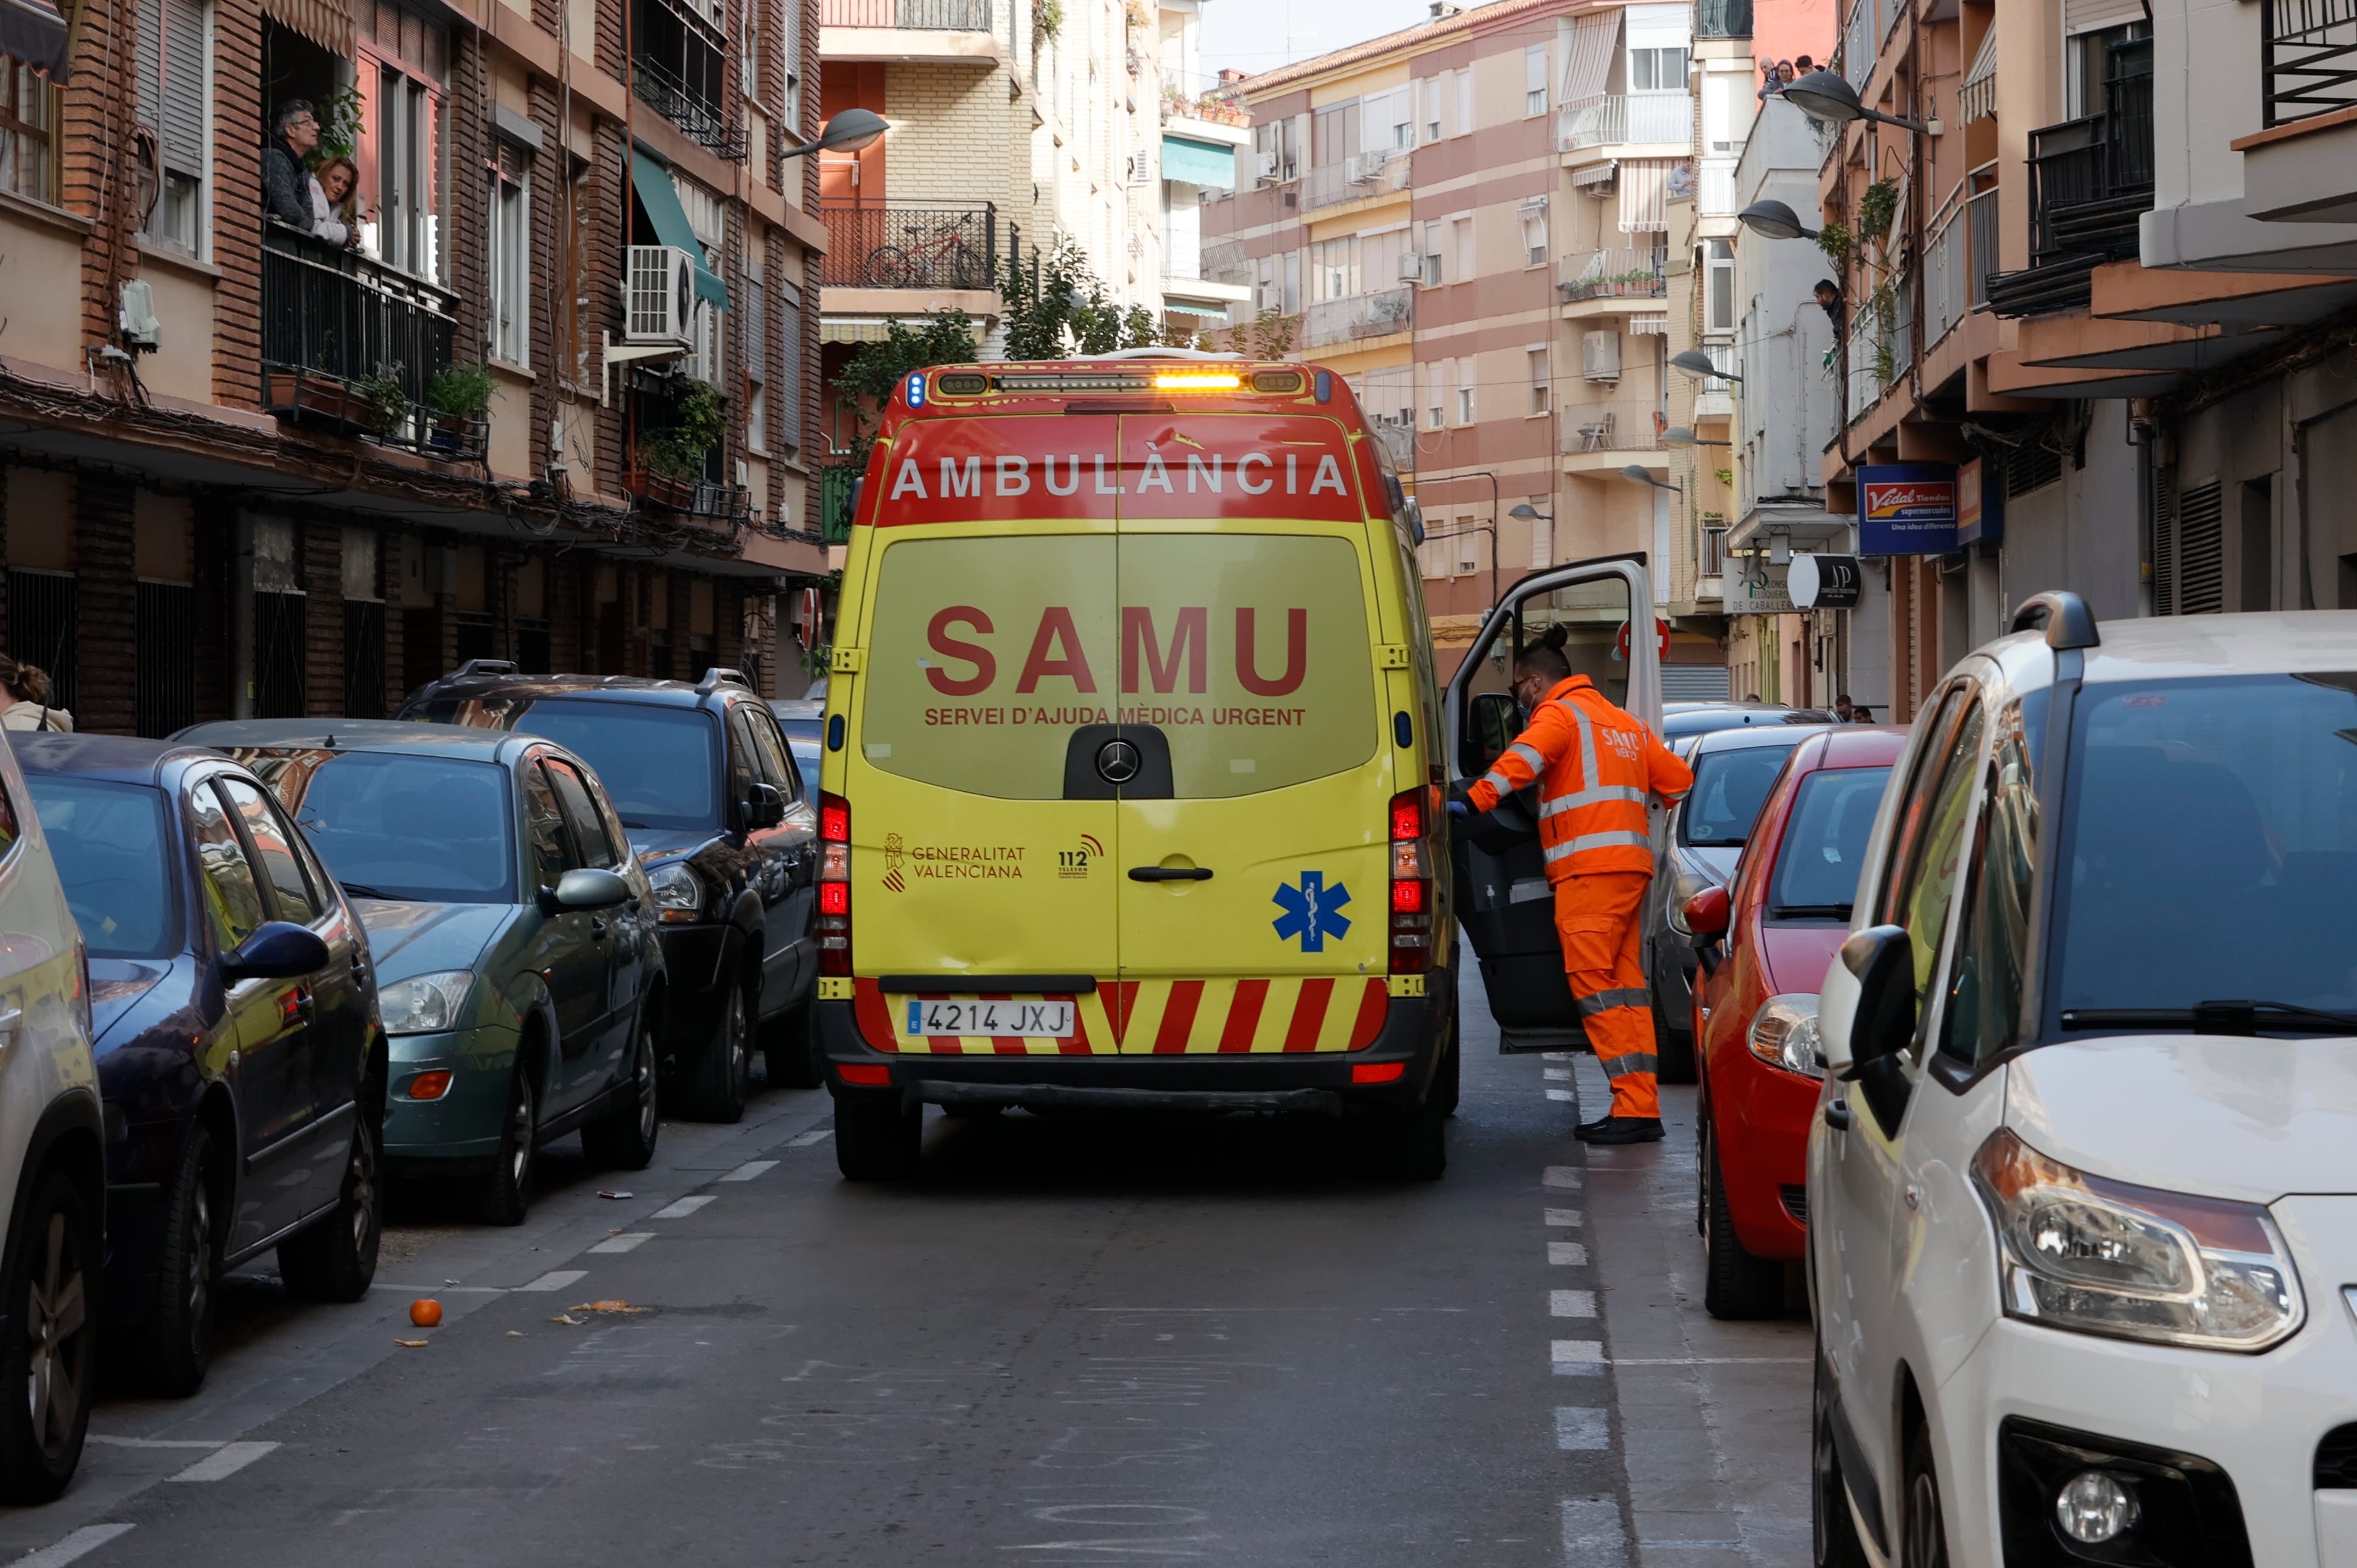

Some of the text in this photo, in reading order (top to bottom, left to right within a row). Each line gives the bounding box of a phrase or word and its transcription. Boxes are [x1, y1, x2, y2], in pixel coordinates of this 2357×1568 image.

[891, 441, 1348, 500] AMBULÀNCIA
[1869, 488, 1915, 511] Vidal
[1901, 505, 1950, 516] supermercados
[1733, 601, 1795, 611] DE CABALLER
[925, 604, 1308, 697] SAMU
[925, 702, 1307, 726] SERVEI D'AJUDA MÈDICA URGENT
[912, 847, 1026, 860] GENERALITAT
[1059, 851, 1087, 866] 112
[914, 865, 1023, 878] VALENCIANA
[911, 1021, 917, 1029] E
[927, 1004, 1065, 1032] 4214 JXJ
